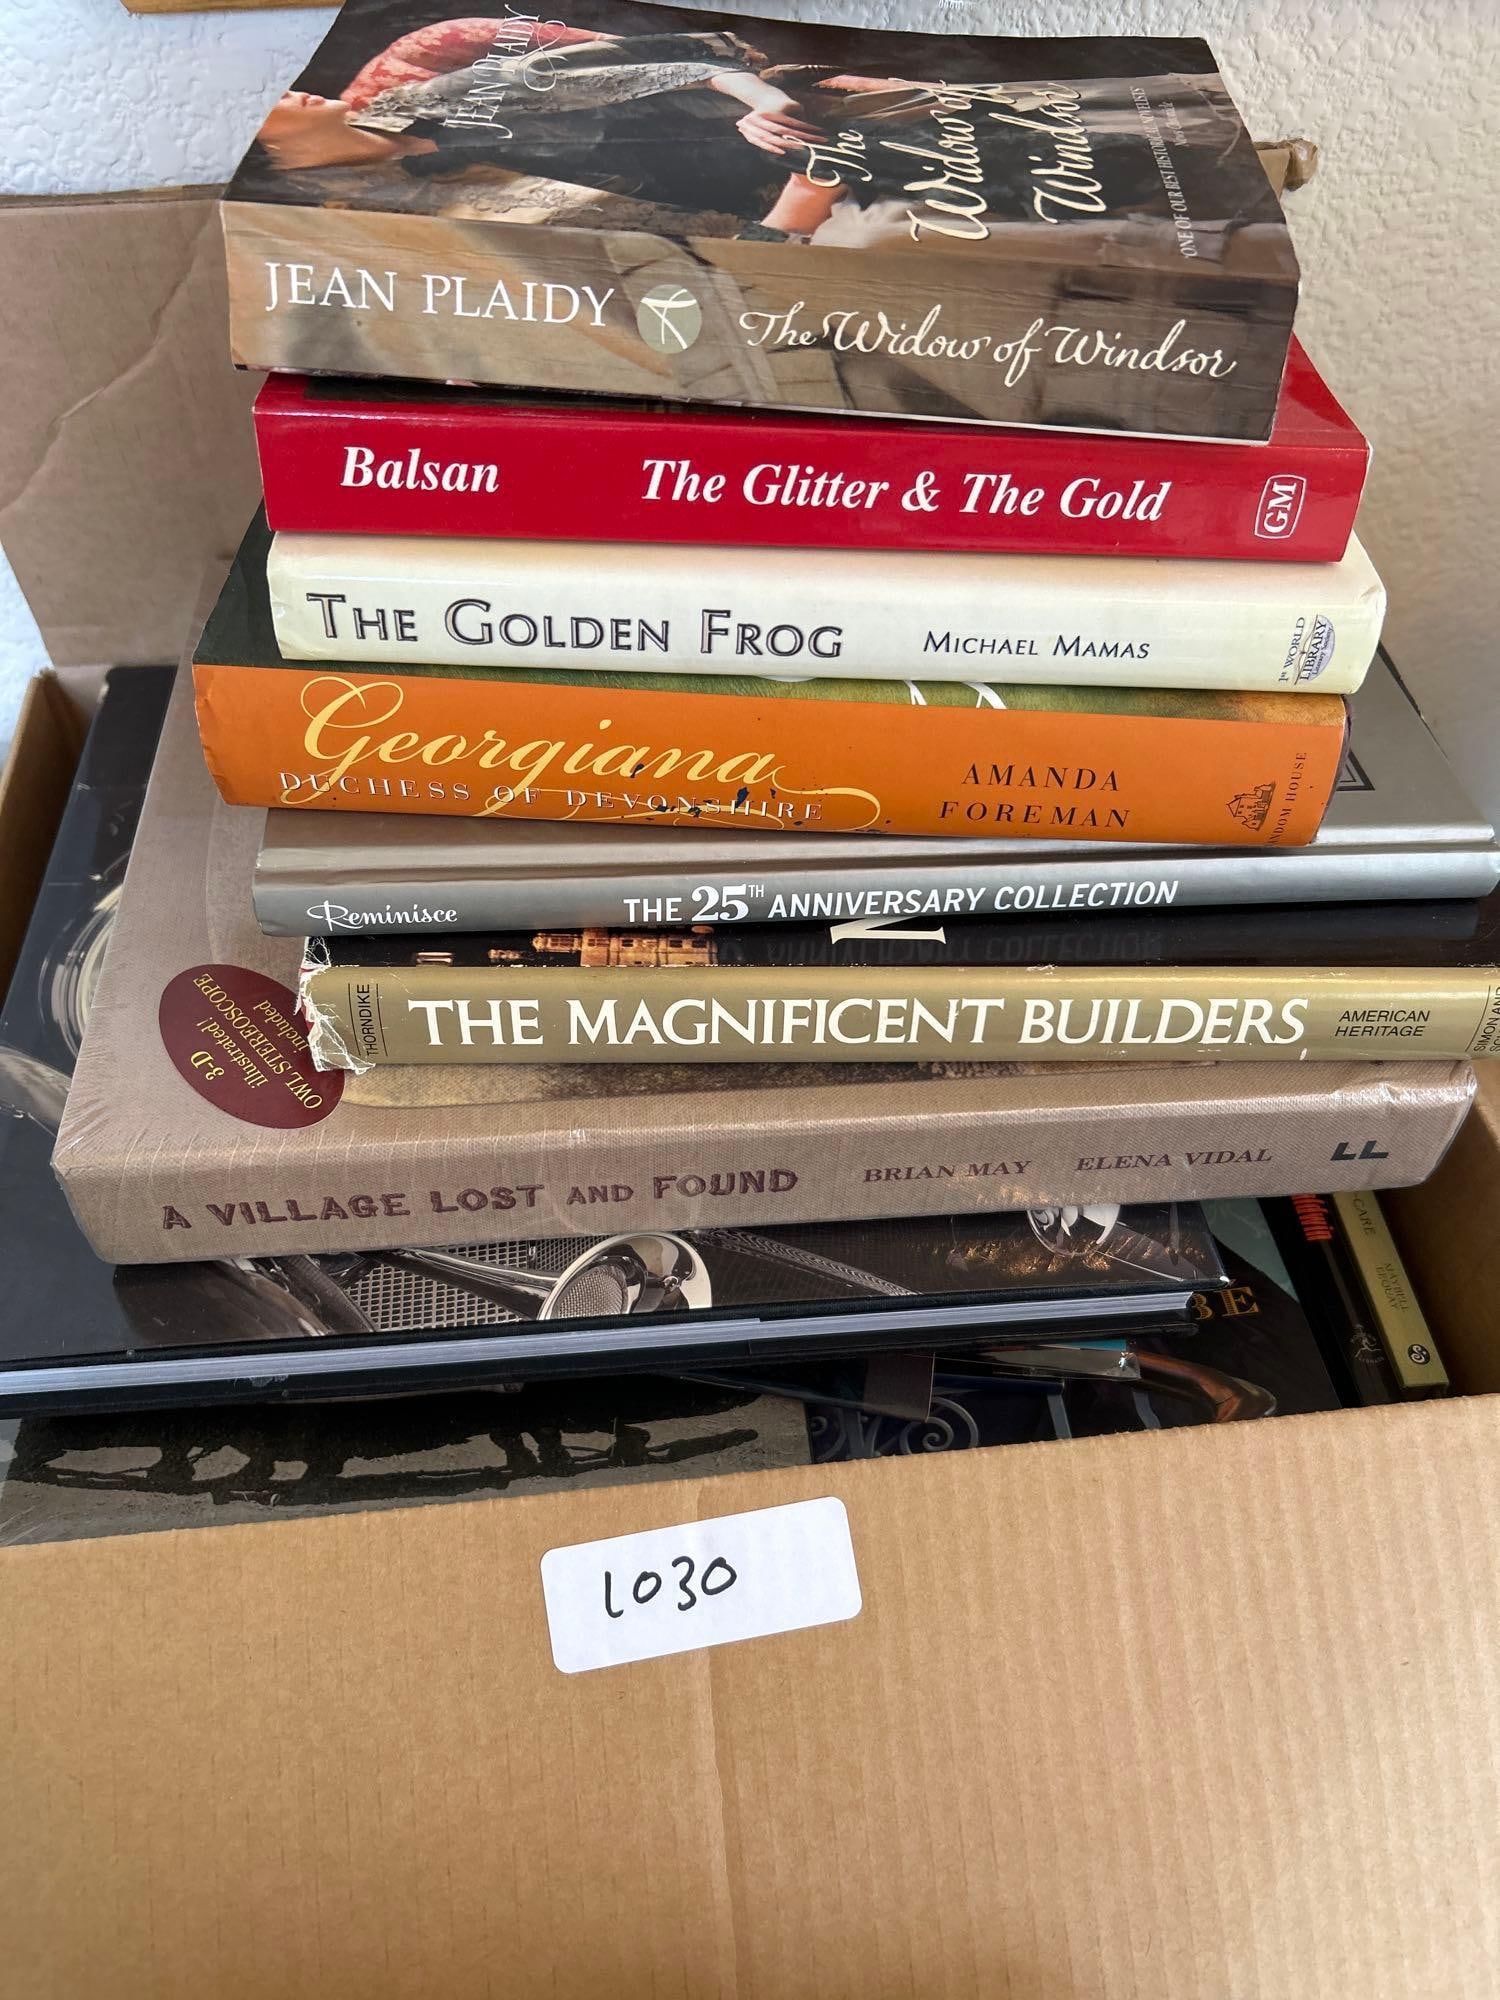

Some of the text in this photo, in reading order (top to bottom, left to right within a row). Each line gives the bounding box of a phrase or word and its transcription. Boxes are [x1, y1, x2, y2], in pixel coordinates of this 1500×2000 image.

[439, 4, 540, 139] JEAN PLAIDY
[782, 129, 873, 187] The
[879, 110, 990, 242] Widow
[988, 82, 1107, 224] Windsor
[1160, 170, 1182, 190] BEST
[1167, 191, 1188, 212] OUR
[1173, 214, 1192, 230] OF
[265, 261, 616, 328] JEAN PLAIDY
[739, 302, 1240, 388] The Widow of Windsor
[340, 446, 499, 493] Balsan
[641, 459, 1173, 523] The Glitter & The Gold
[1263, 480, 1299, 535] GM
[306, 592, 842, 657] THE GOLDEN FROG
[923, 630, 1151, 660] MICHAEL MAMAS
[1283, 616, 1306, 669] WORLD
[1300, 620, 1327, 681] LIBRARY
[283, 676, 790, 816] Georgiana
[279, 771, 824, 821] DUCHESS OF DEVONSHIRE
[961, 762, 1121, 793] AMANDA
[1285, 752, 1307, 801] HOUSE
[938, 800, 1130, 831] FOREMAN
[306, 899, 458, 931] Reminisce
[623, 897, 682, 923] THE
[768, 887, 987, 919] ANNIVERSARY
[994, 880, 1180, 912] COLLECTION
[193, 972, 323, 1110] OWL STEREOSCOPE
[252, 999, 309, 1055] included
[356, 983, 380, 1057] THORNDIKE
[408, 997, 1310, 1046] THE MAGNIFICENT BUILDERS
[1335, 1025, 1427, 1037] HERITAGE
[1338, 1010, 1431, 1023] AMERICAN
[1473, 1017, 1500, 1052] SIMON
[190, 1050, 226, 1082] 3-D
[196, 1016, 270, 1089] illustrated!
[862, 1158, 1033, 1184] BRIAN MAY
[1074, 1147, 1273, 1172] ELENA VIDAL
[161, 1167, 799, 1231] A VILLAGE LOST AND FOUND
[604, 1554, 737, 1619] 1030
